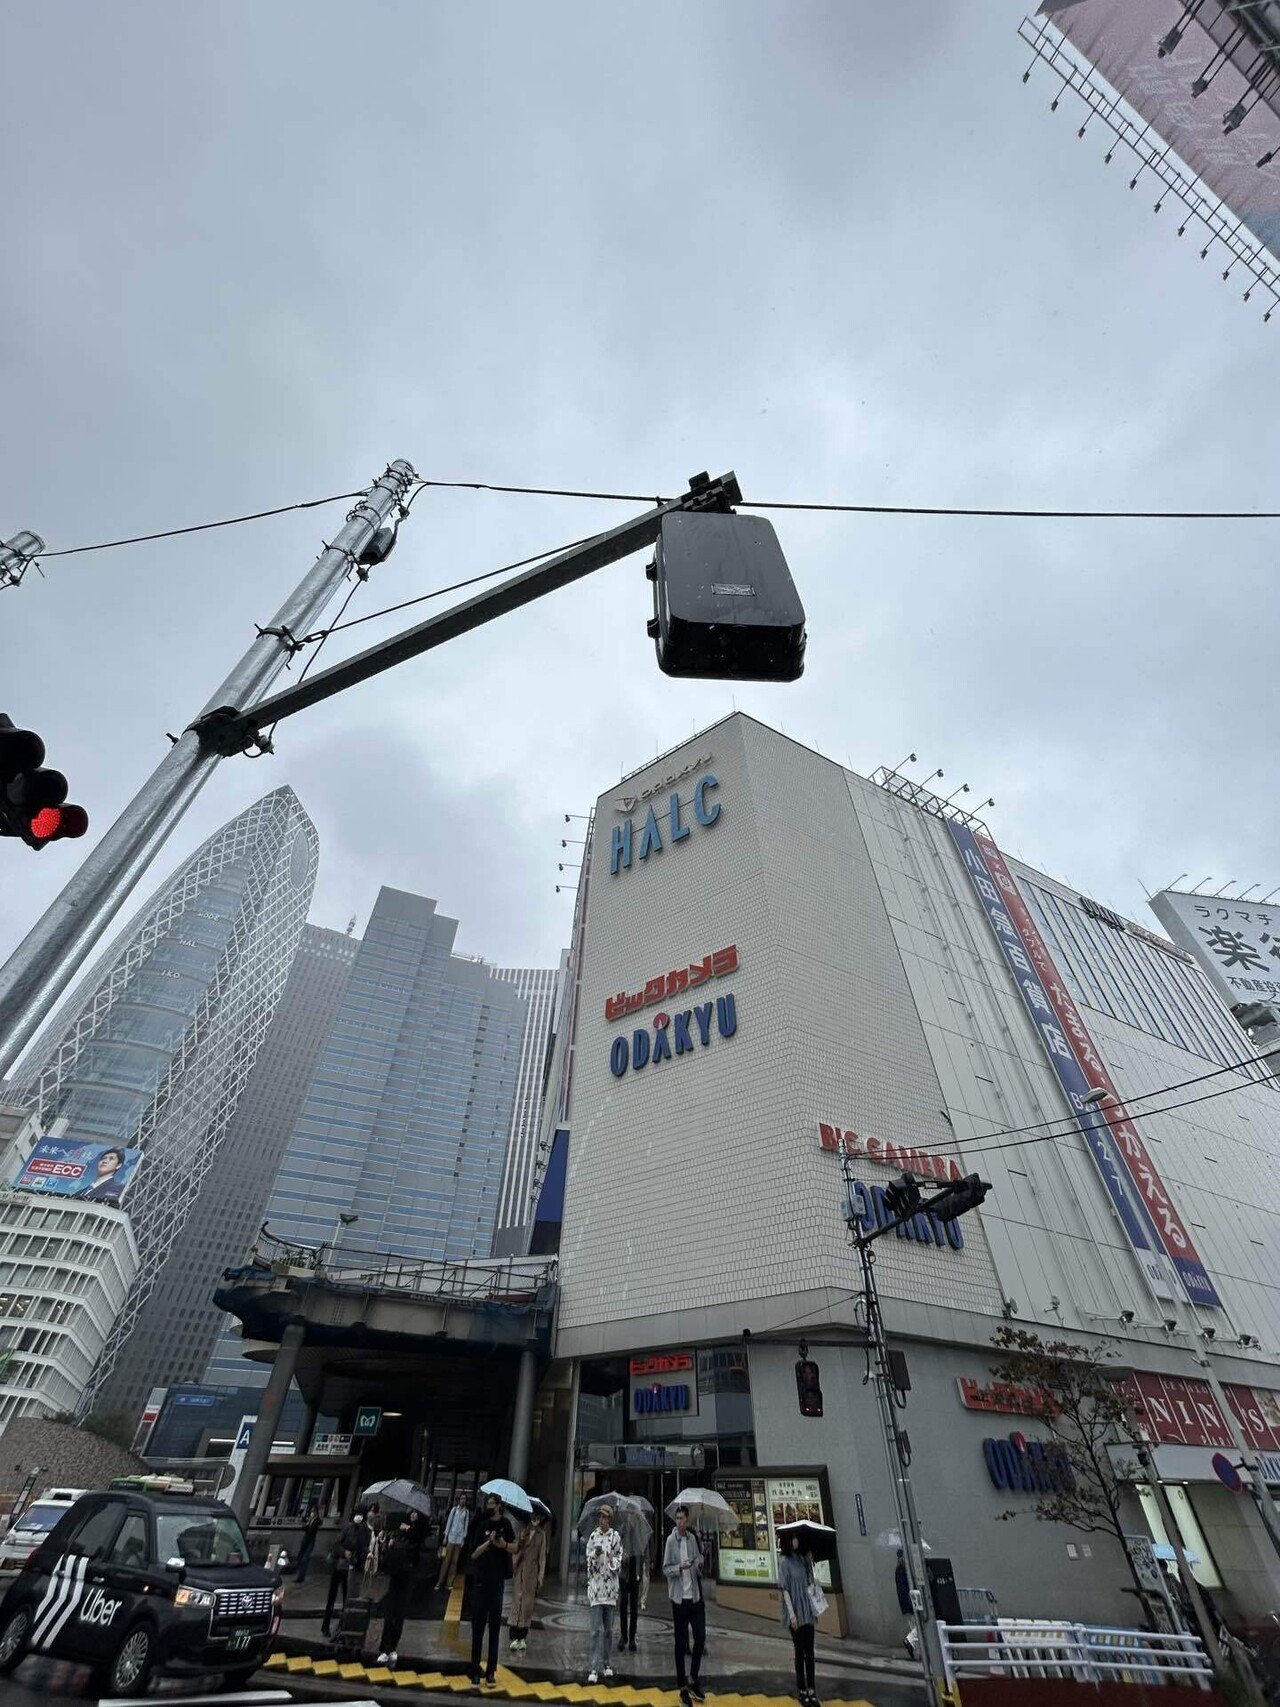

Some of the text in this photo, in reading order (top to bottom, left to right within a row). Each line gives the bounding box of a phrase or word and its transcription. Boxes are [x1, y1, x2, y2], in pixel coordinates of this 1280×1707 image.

[610, 774, 722, 876] HALC
[1195, 905, 1273, 926] ラクマチ
[179, 939, 198, 948] HAL
[964, 849, 1073, 1061] 小田急百貨店
[604, 944, 740, 1022] ビックカメラ
[610, 993, 737, 1077] ODAKYU
[52, 1164, 82, 1176] ECC
[633, 1382, 689, 1415] ODAKYU
[1147, 1397, 1265, 1433] NIN'S
[80, 1588, 123, 1627] Uber
